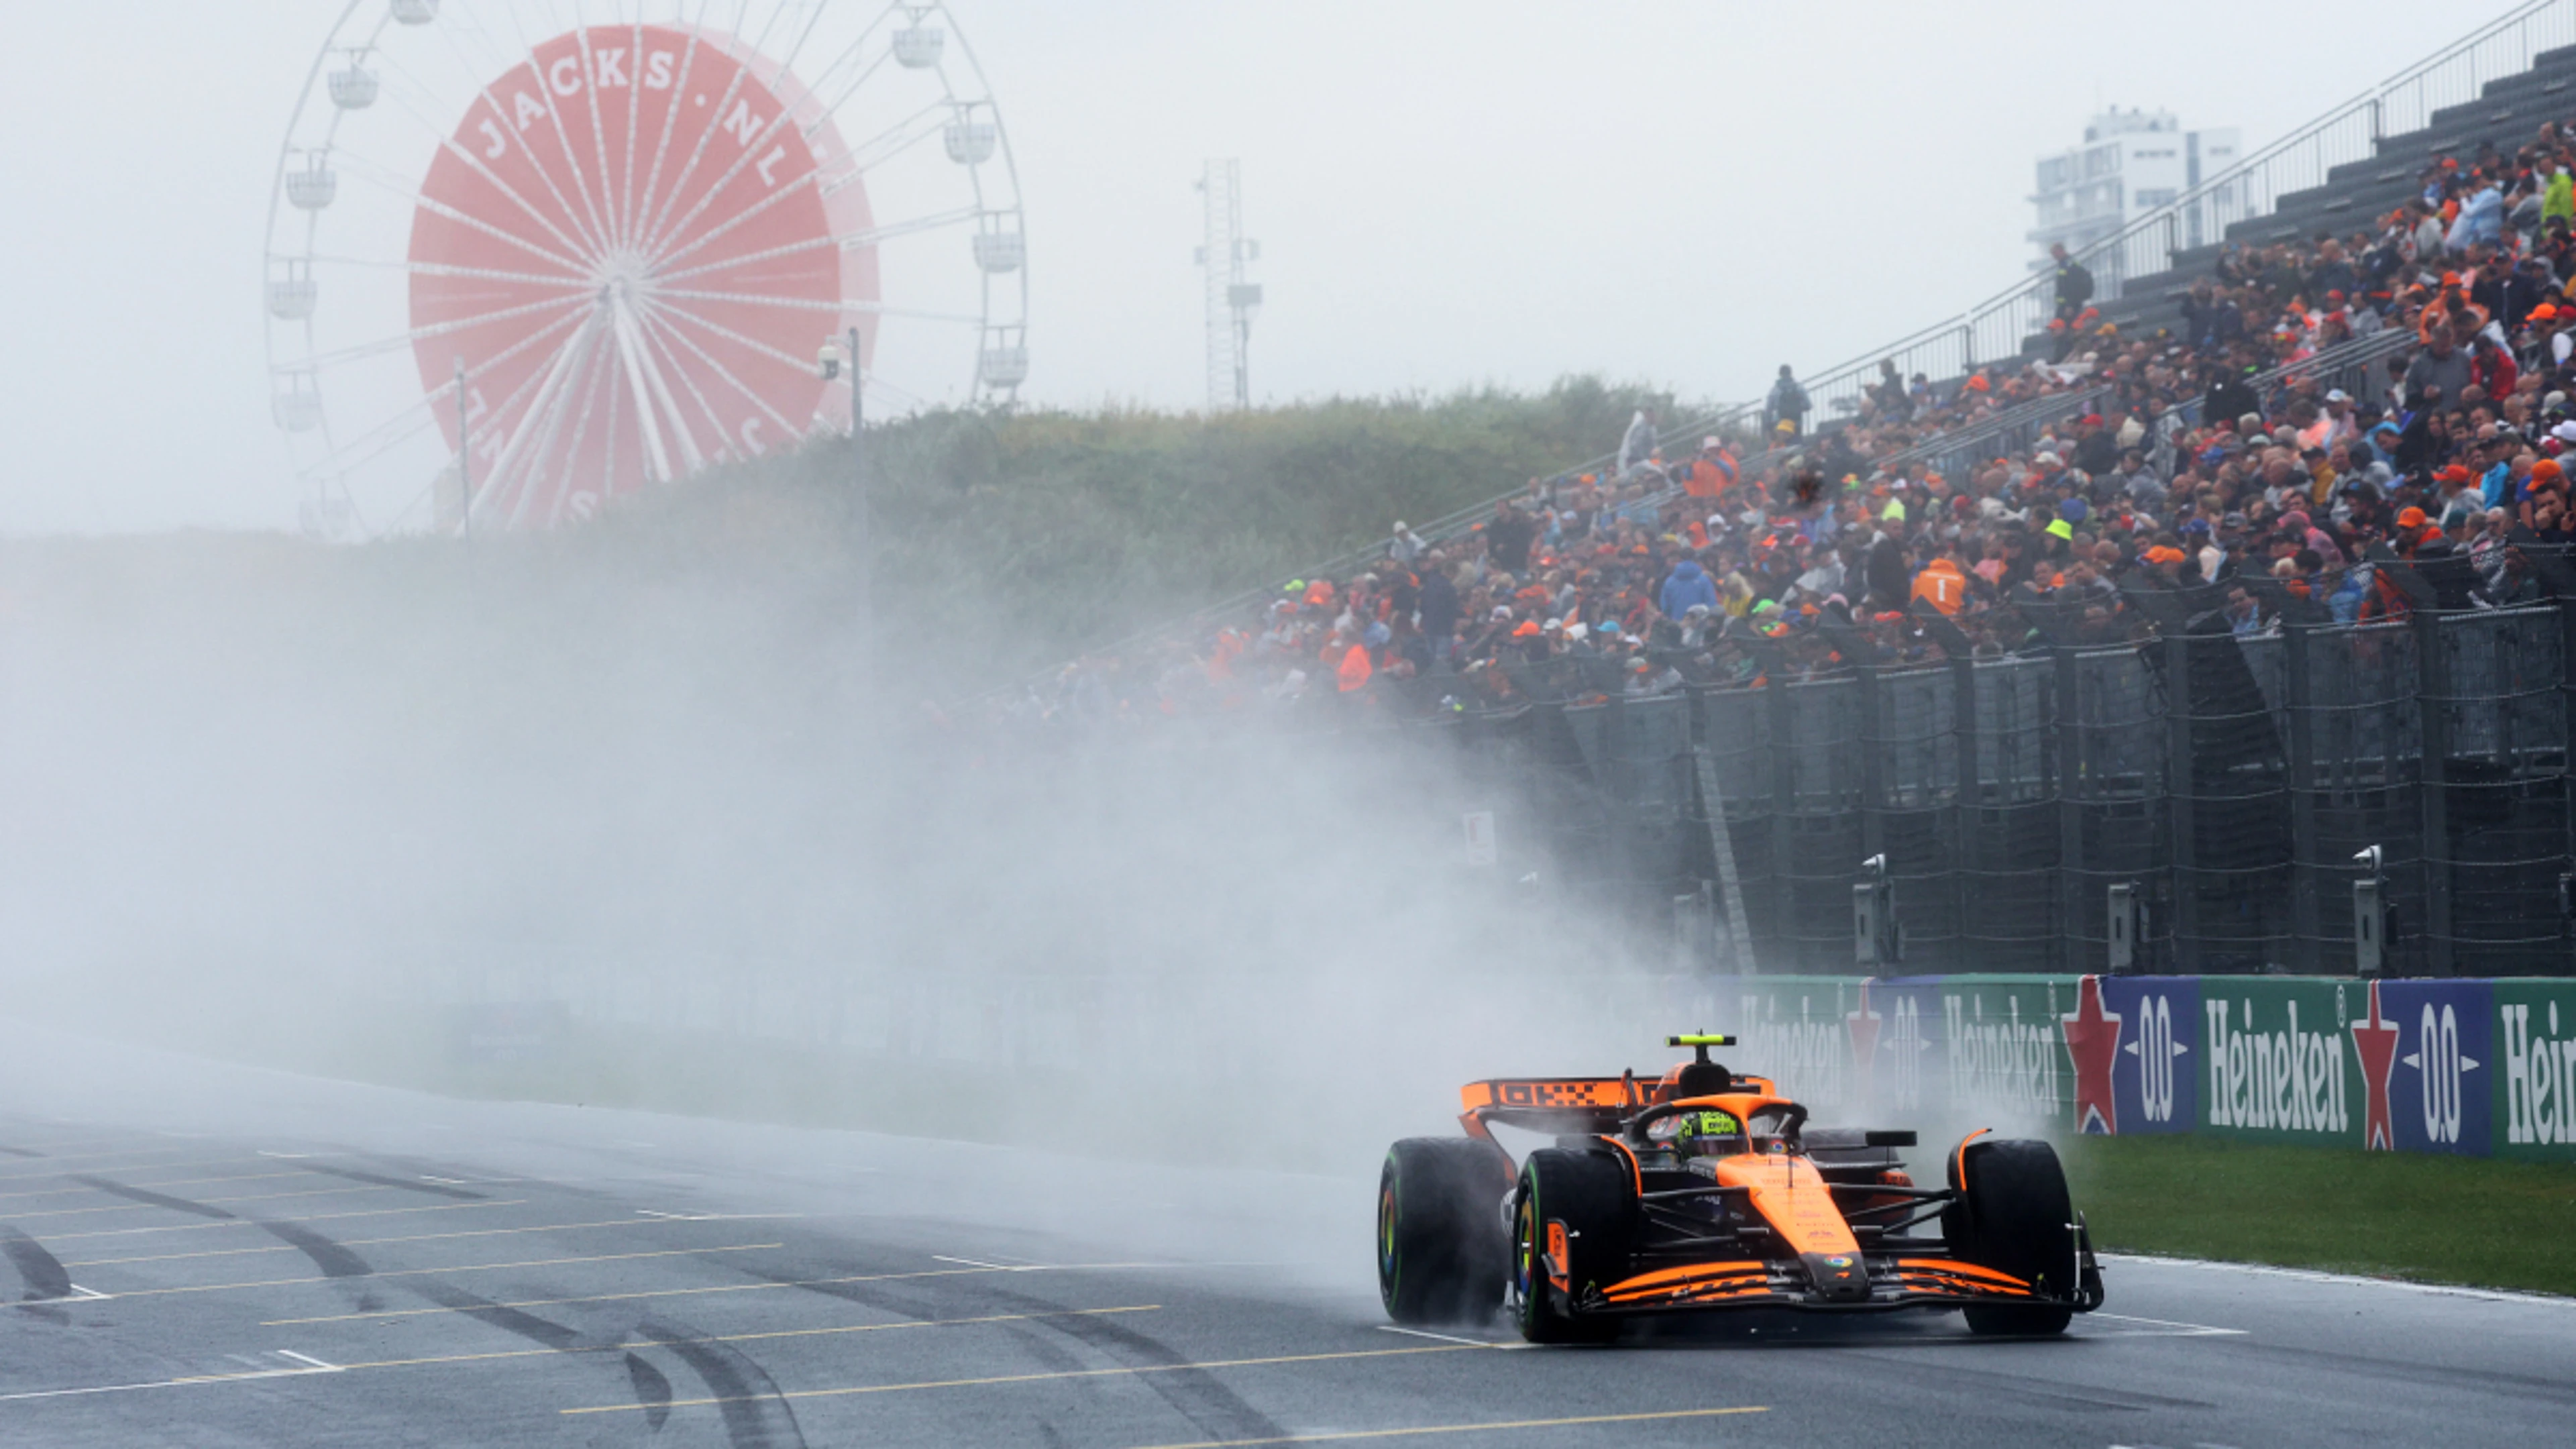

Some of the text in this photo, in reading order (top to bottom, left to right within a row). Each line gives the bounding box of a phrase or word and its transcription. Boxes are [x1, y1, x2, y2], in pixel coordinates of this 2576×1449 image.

[479, 48, 786, 186] JACKS.NL
[1945, 994, 2059, 1116] Heineken
[2206, 998, 2348, 1132] Heineken
